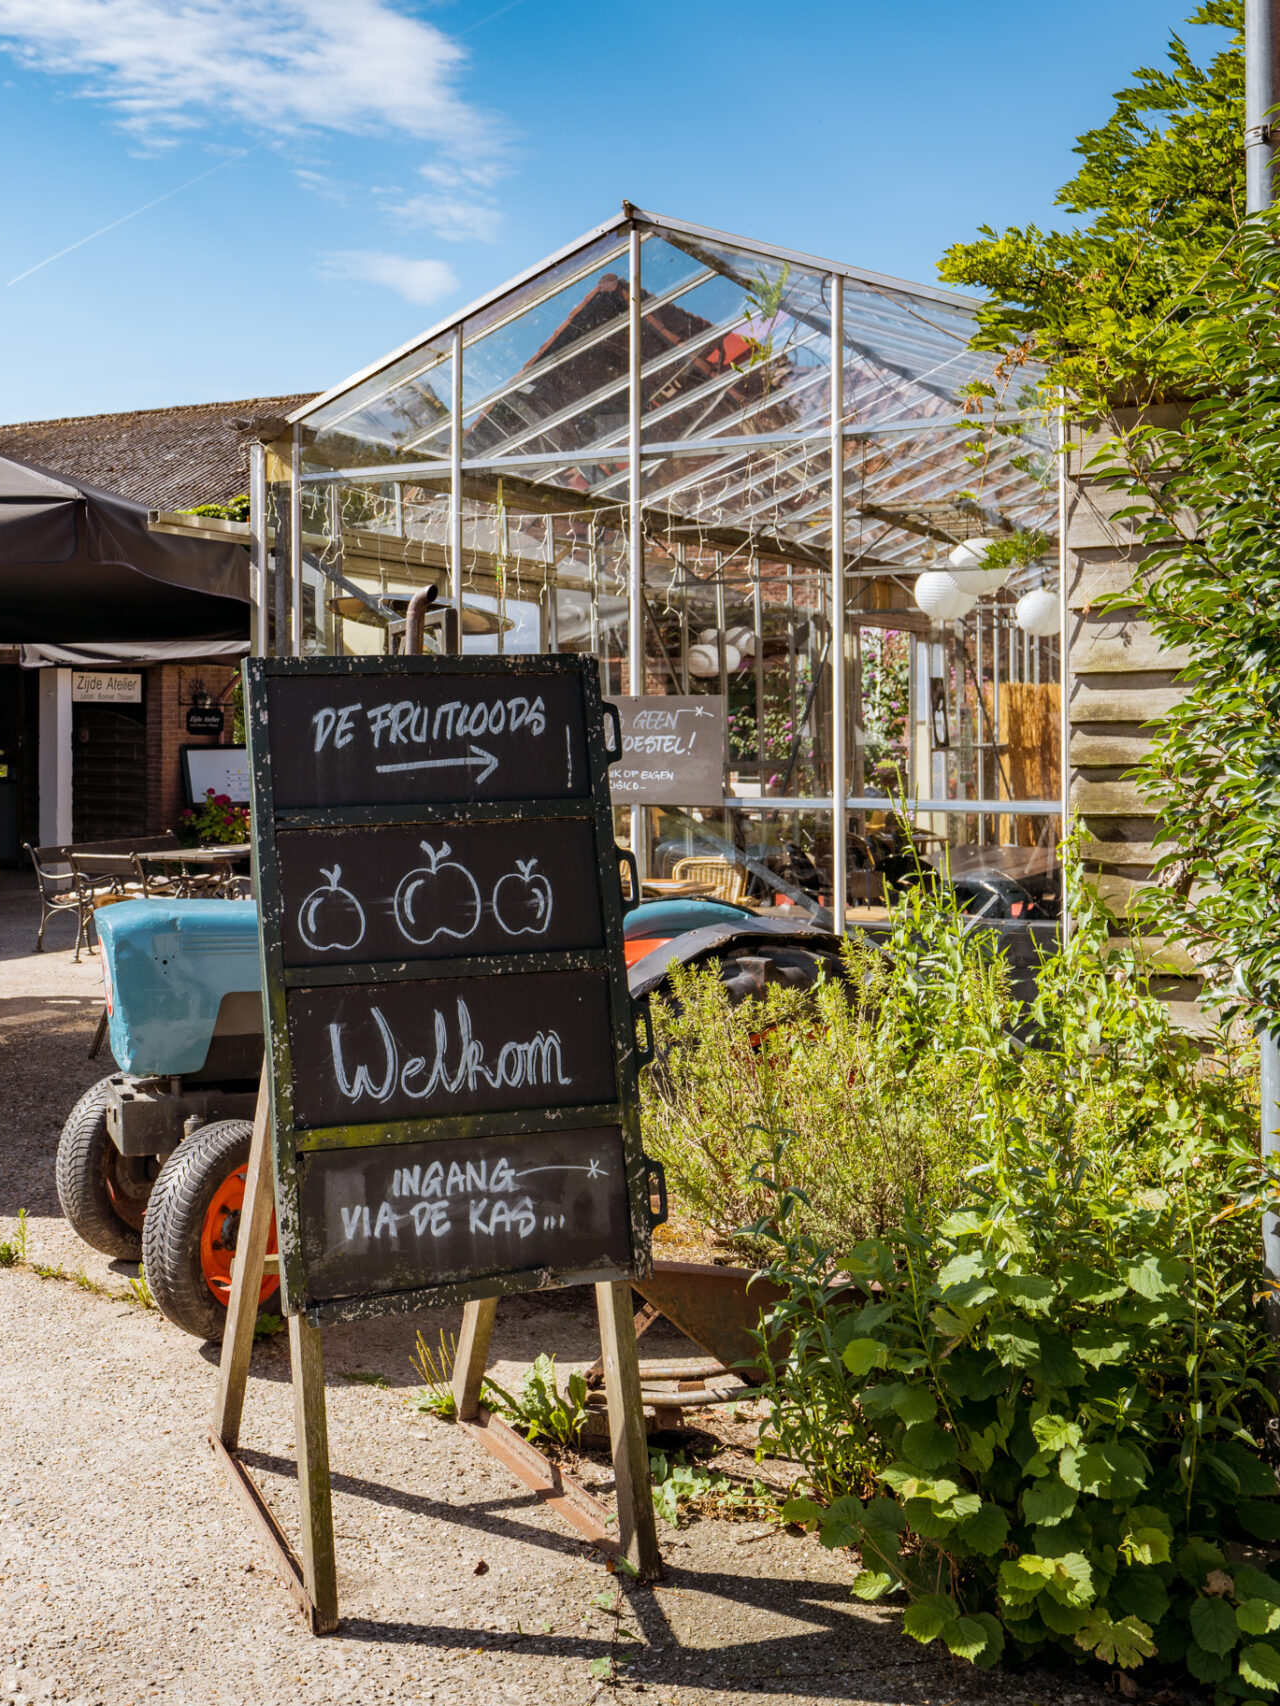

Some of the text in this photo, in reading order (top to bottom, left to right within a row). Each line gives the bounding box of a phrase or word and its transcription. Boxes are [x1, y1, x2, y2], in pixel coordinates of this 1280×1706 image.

[77, 676, 137, 693] Zijde Atelier
[313, 696, 546, 753] DE FRUITLOODS
[632, 710, 679, 729] GEEN
[623, 770, 639, 778] OP
[640, 770, 674, 781] EIGEN
[328, 995, 572, 1104] Welkom
[392, 1157, 516, 1198] INGANG
[341, 1201, 398, 1240] VIA
[410, 1199, 451, 1238] DE
